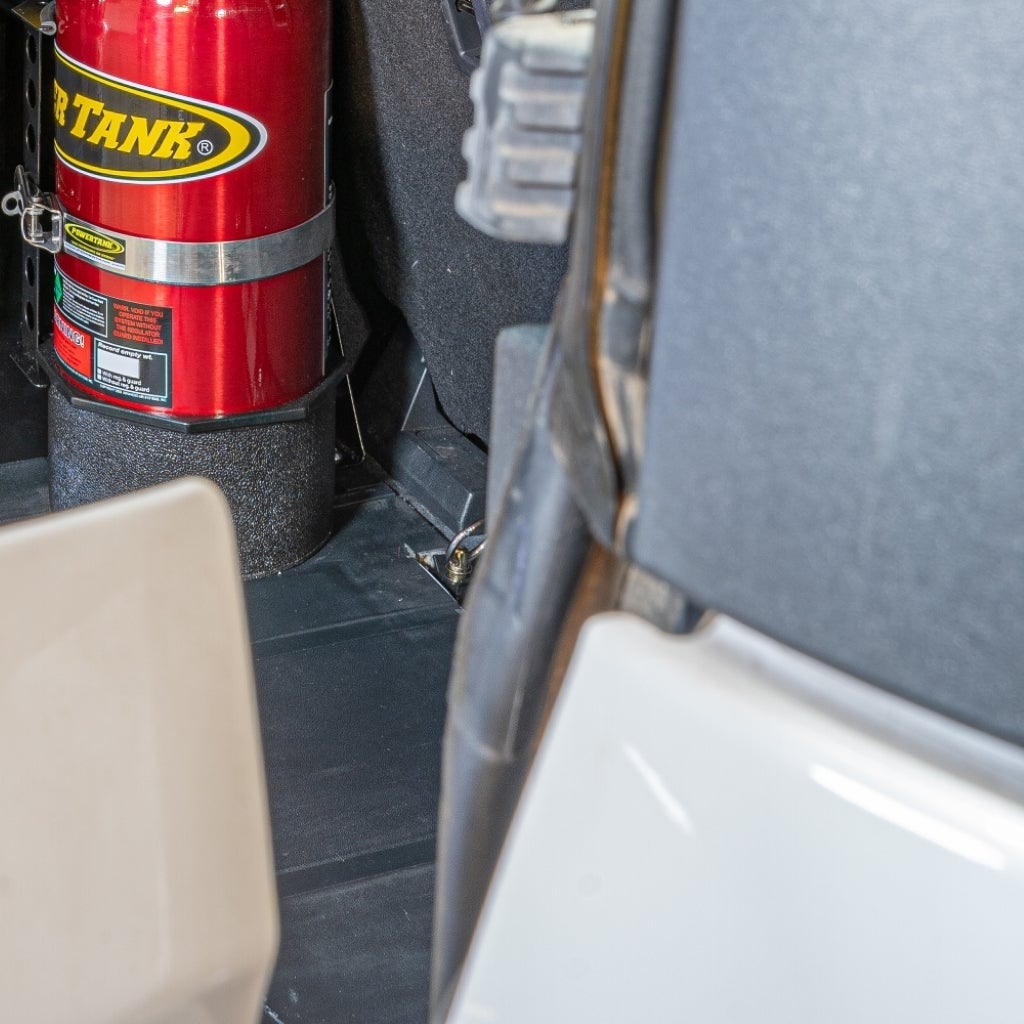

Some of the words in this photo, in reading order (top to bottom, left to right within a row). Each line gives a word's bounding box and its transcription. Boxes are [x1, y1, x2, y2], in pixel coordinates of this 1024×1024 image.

[70, 94, 205, 160] TANK
[98, 341, 120, 353] Record
[121, 349, 141, 359] empty
[127, 378, 142, 386] guard
[135, 385, 150, 393] guard
